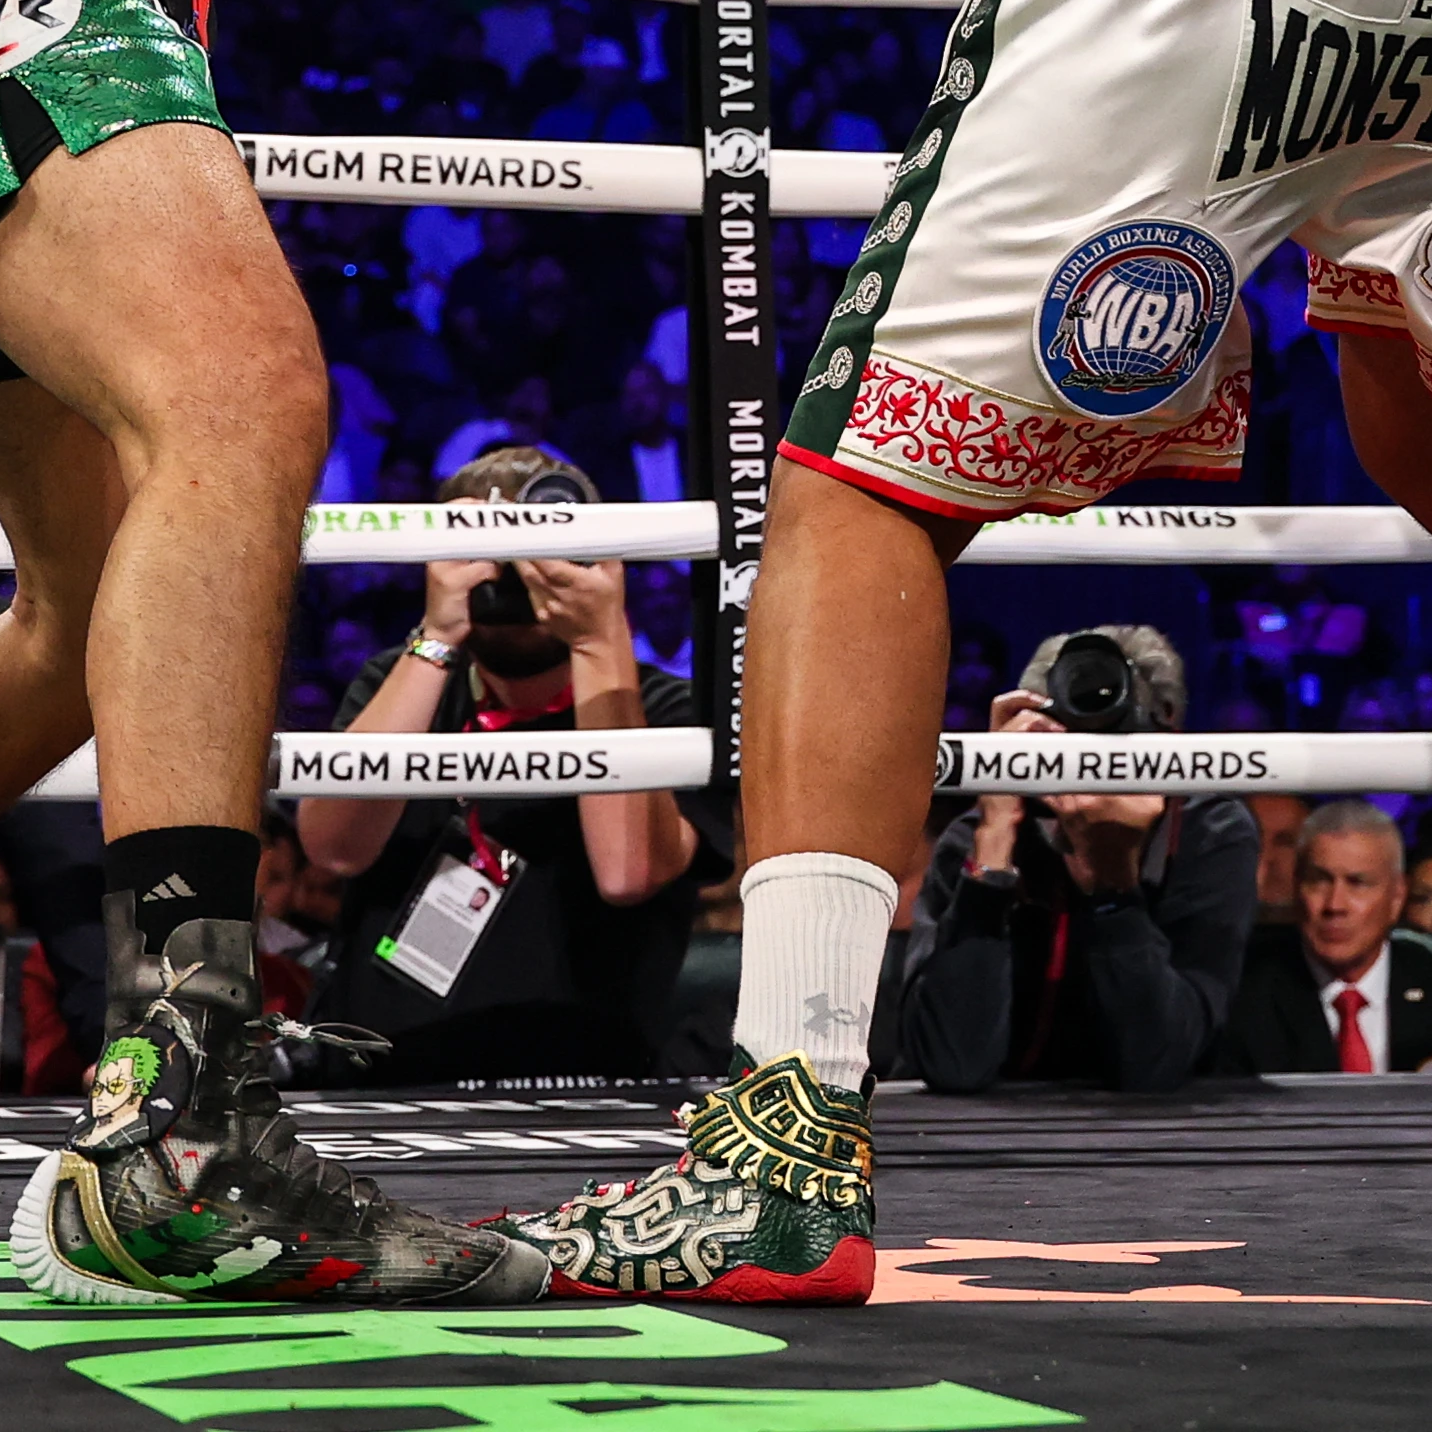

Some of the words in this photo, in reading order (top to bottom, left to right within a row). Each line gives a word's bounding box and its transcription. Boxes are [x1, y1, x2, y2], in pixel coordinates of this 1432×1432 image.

[266, 148, 366, 183] MGM
[379, 153, 584, 190] REWARDS
[719, 191, 761, 347] KOMBAT
[1051, 243, 1105, 300] WORLD
[1105, 227, 1180, 250] BOXING
[1082, 273, 1196, 360] WBA
[728, 400, 766, 551] MORTAL
[291, 751, 390, 782] MGM
[406, 749, 610, 782] REWARDS
[972, 752, 1064, 780] MGM
[1077, 751, 1268, 781] REWARDS
